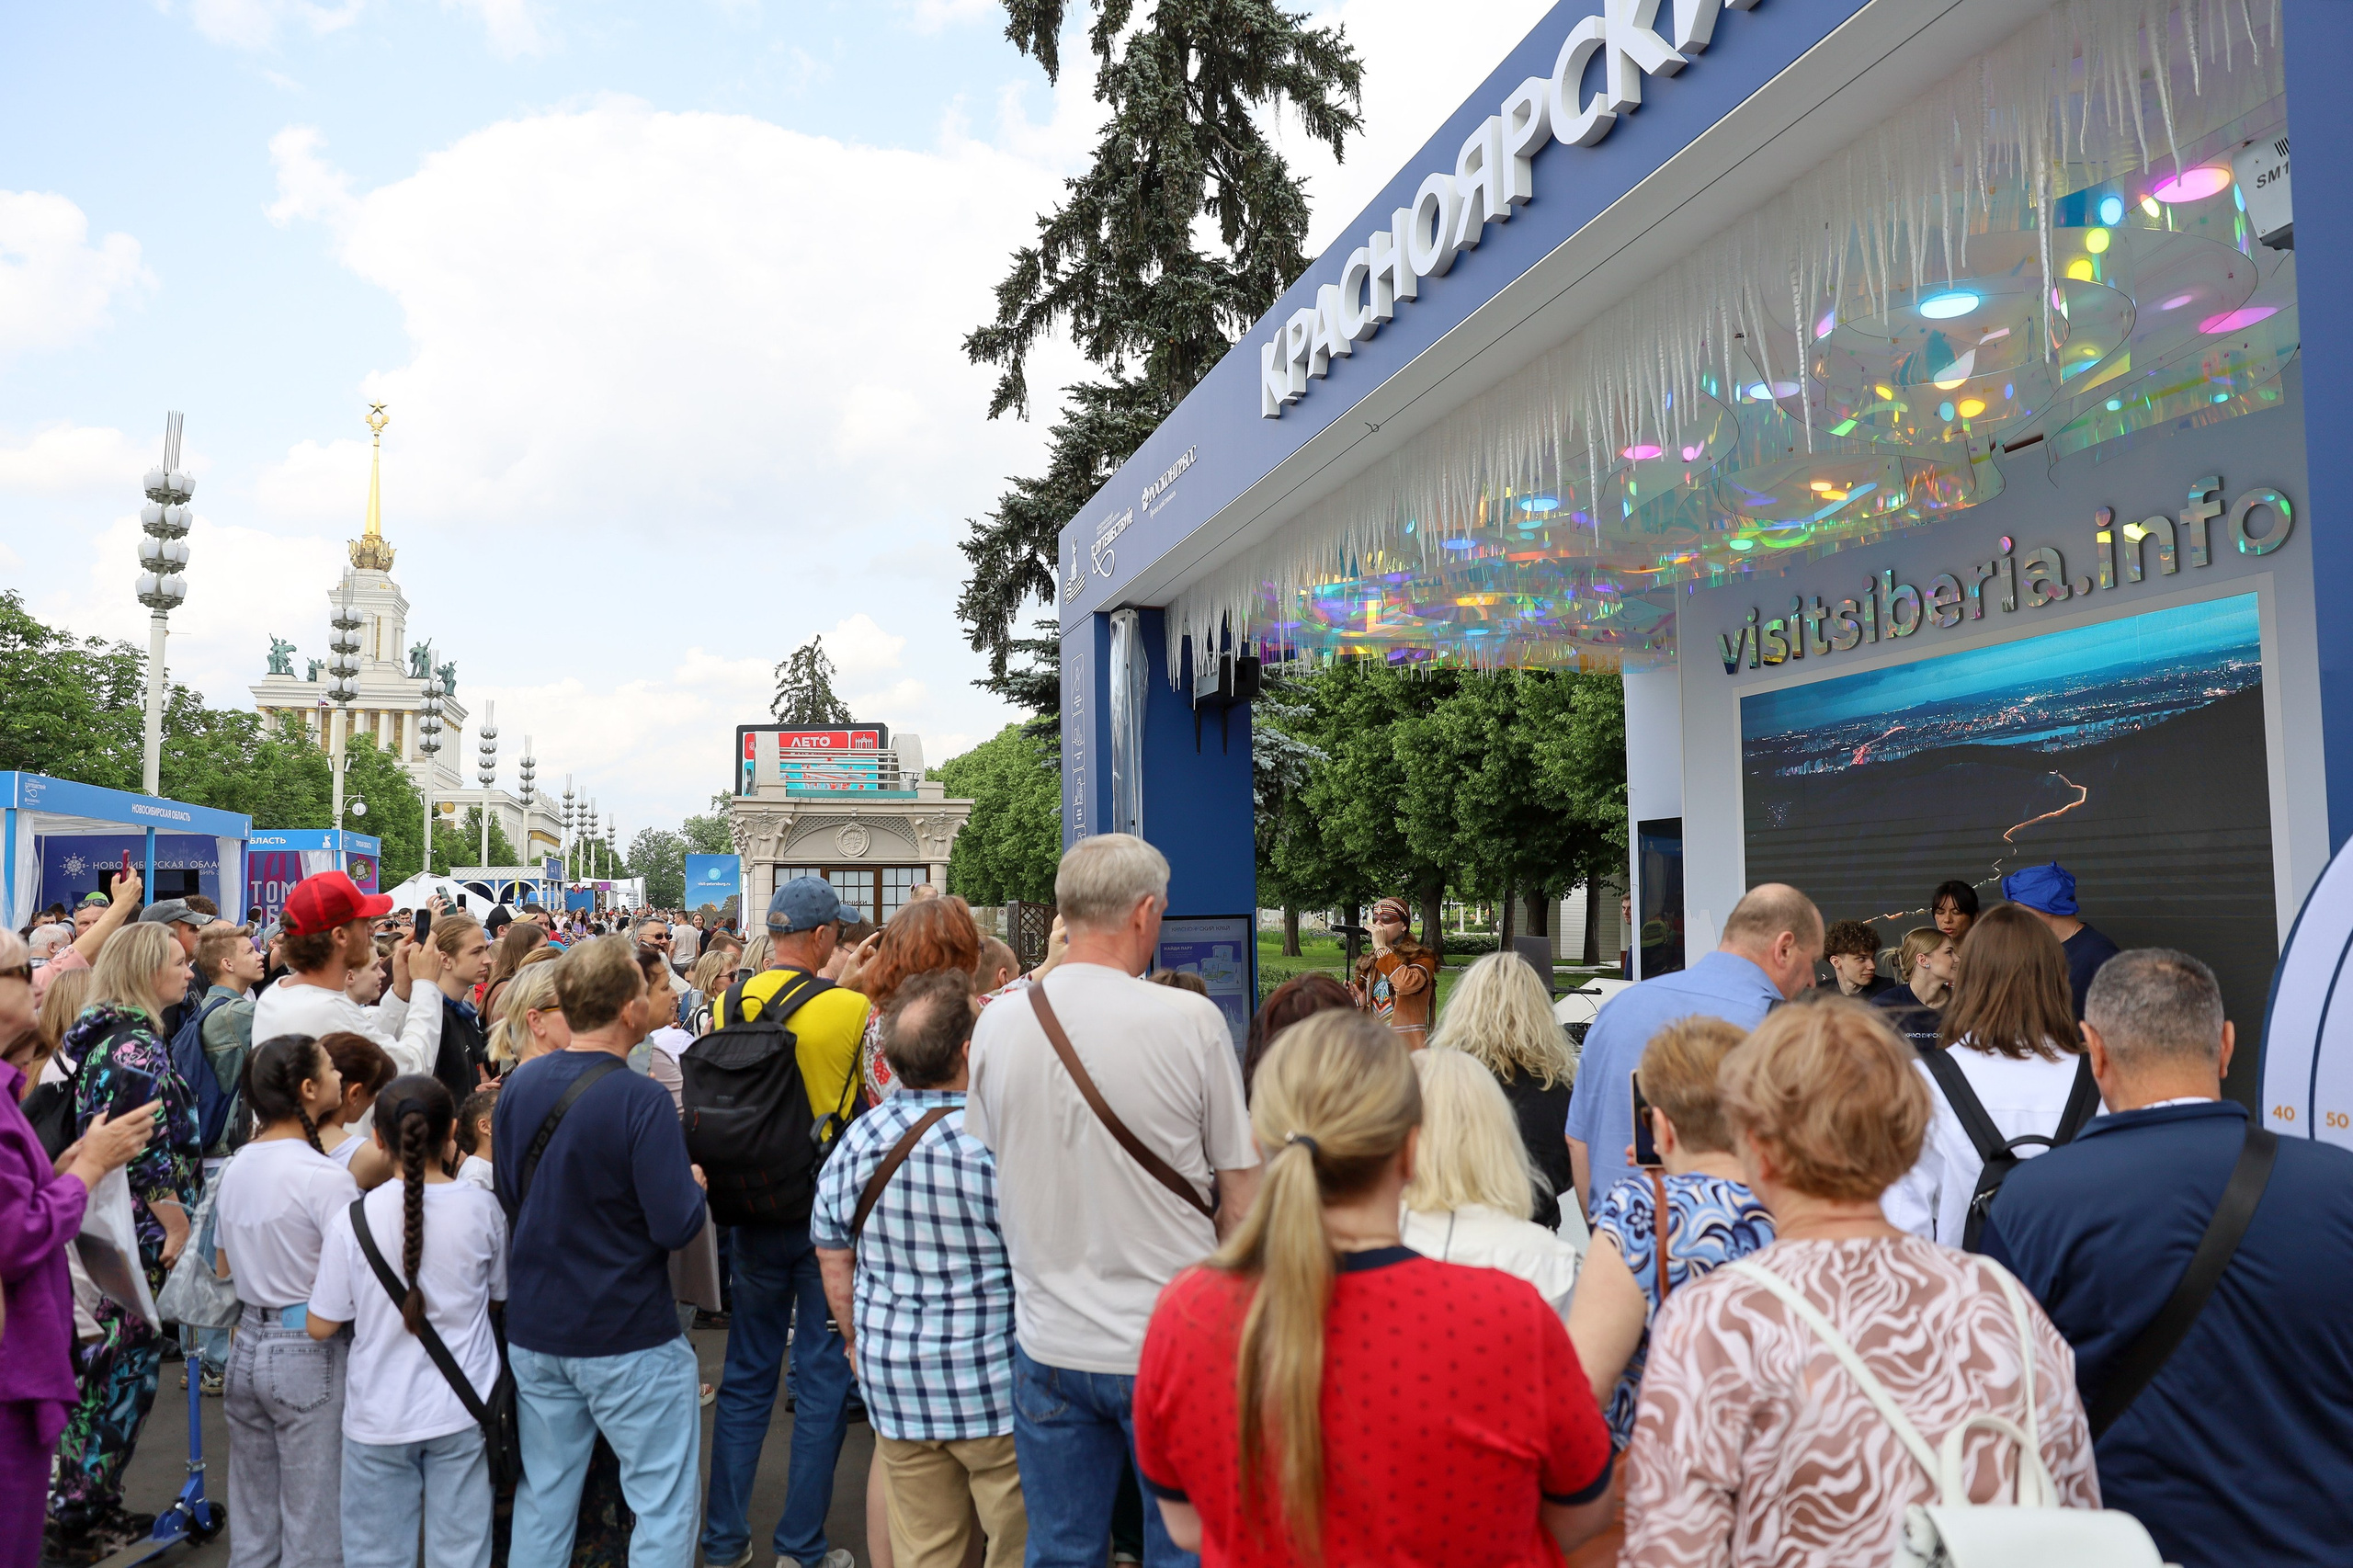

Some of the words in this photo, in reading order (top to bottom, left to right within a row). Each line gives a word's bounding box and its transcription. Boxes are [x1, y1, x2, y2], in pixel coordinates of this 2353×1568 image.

[1716, 475, 2294, 676] visitsiberia.info
[790, 736, 831, 747] ЛЕТО
[131, 803, 172, 818] НОВОСИБИРСКАЯ
[172, 810, 191, 822] ОБЛАСТЬ
[250, 836, 287, 845] БЛАСТЬ
[93, 860, 184, 869] НОВОИБРСКАЯ
[189, 860, 220, 869] ОБЛА
[2272, 1106, 2295, 1121] 40
[2325, 1111, 2349, 1129] 50
